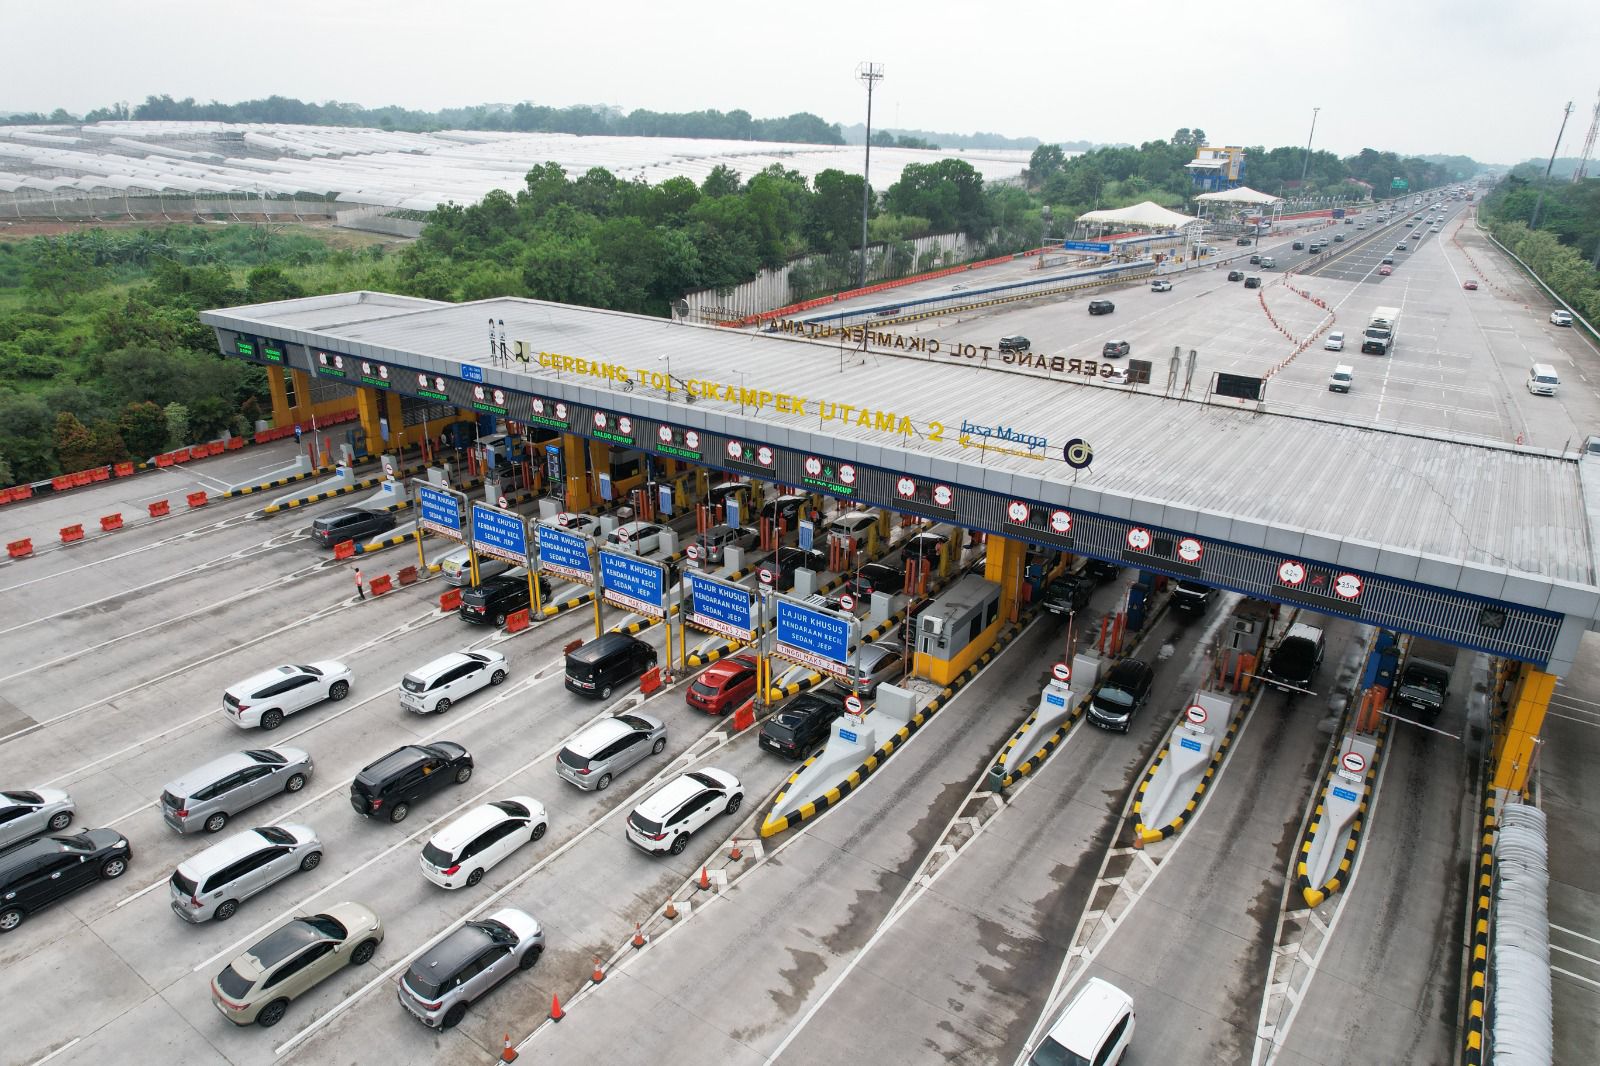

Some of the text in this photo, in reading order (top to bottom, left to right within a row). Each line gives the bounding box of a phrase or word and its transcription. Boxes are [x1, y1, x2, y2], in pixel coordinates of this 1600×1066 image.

[539, 351, 944, 442] GERBANG TOL CIKAMPEK UTAMA 2
[997, 425, 1047, 450] Marga
[477, 511, 519, 530] LAJUR KHUSUS
[541, 530, 585, 549] LAJUR KHUSUS
[605, 557, 657, 578] LAJUR KHUSUS
[606, 568, 640, 584] KENDARAAN
[641, 579, 656, 590] KECIL
[637, 588, 651, 597] JEEP
[694, 580, 747, 604] LAJUR KHUSUS
[694, 591, 748, 615] KENDARAAN KECIL
[727, 612, 742, 623] JEEP
[782, 608, 843, 635] LAJUR KHUSUS
[782, 620, 843, 646] KENDARAAN KECIL
[791, 633, 832, 652] SEDAN, JEEP
[781, 646, 802, 659] TINGGI
